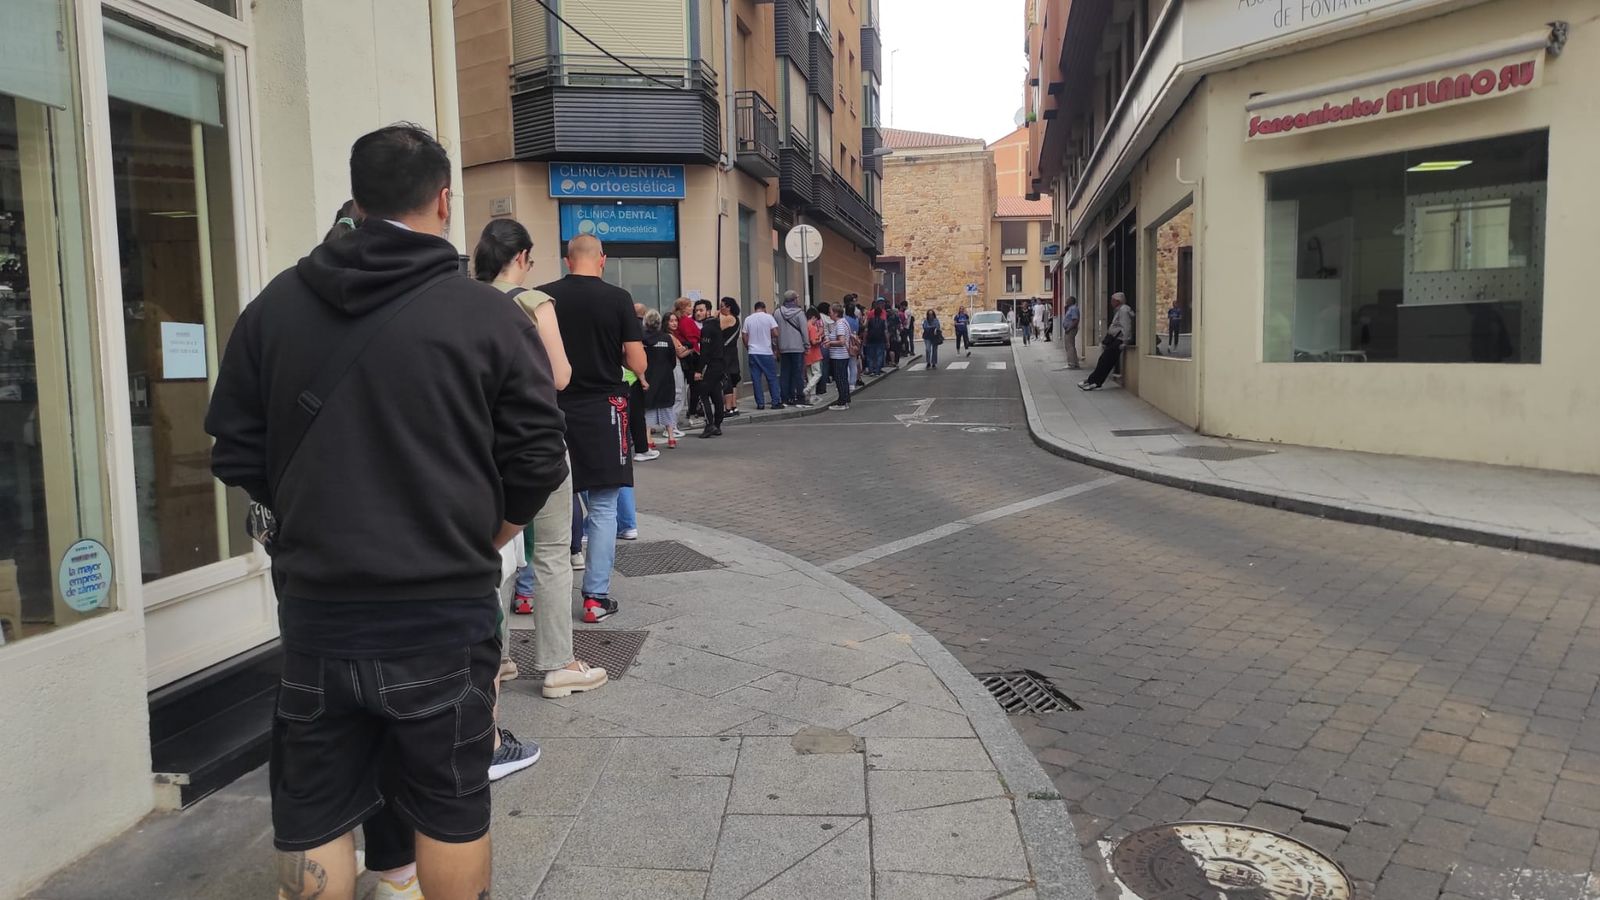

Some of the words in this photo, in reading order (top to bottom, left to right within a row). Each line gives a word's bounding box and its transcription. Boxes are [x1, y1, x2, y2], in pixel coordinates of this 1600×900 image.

[1249, 97, 1383, 137] Saneamientos
[1386, 69, 1496, 112] ATILANO
[618, 167, 675, 179] DENTAL
[618, 210, 658, 220] DENTAL
[69, 567, 76, 576] la
[78, 563, 101, 574] mayor
[69, 573, 102, 585] empresa
[66, 587, 76, 597] de
